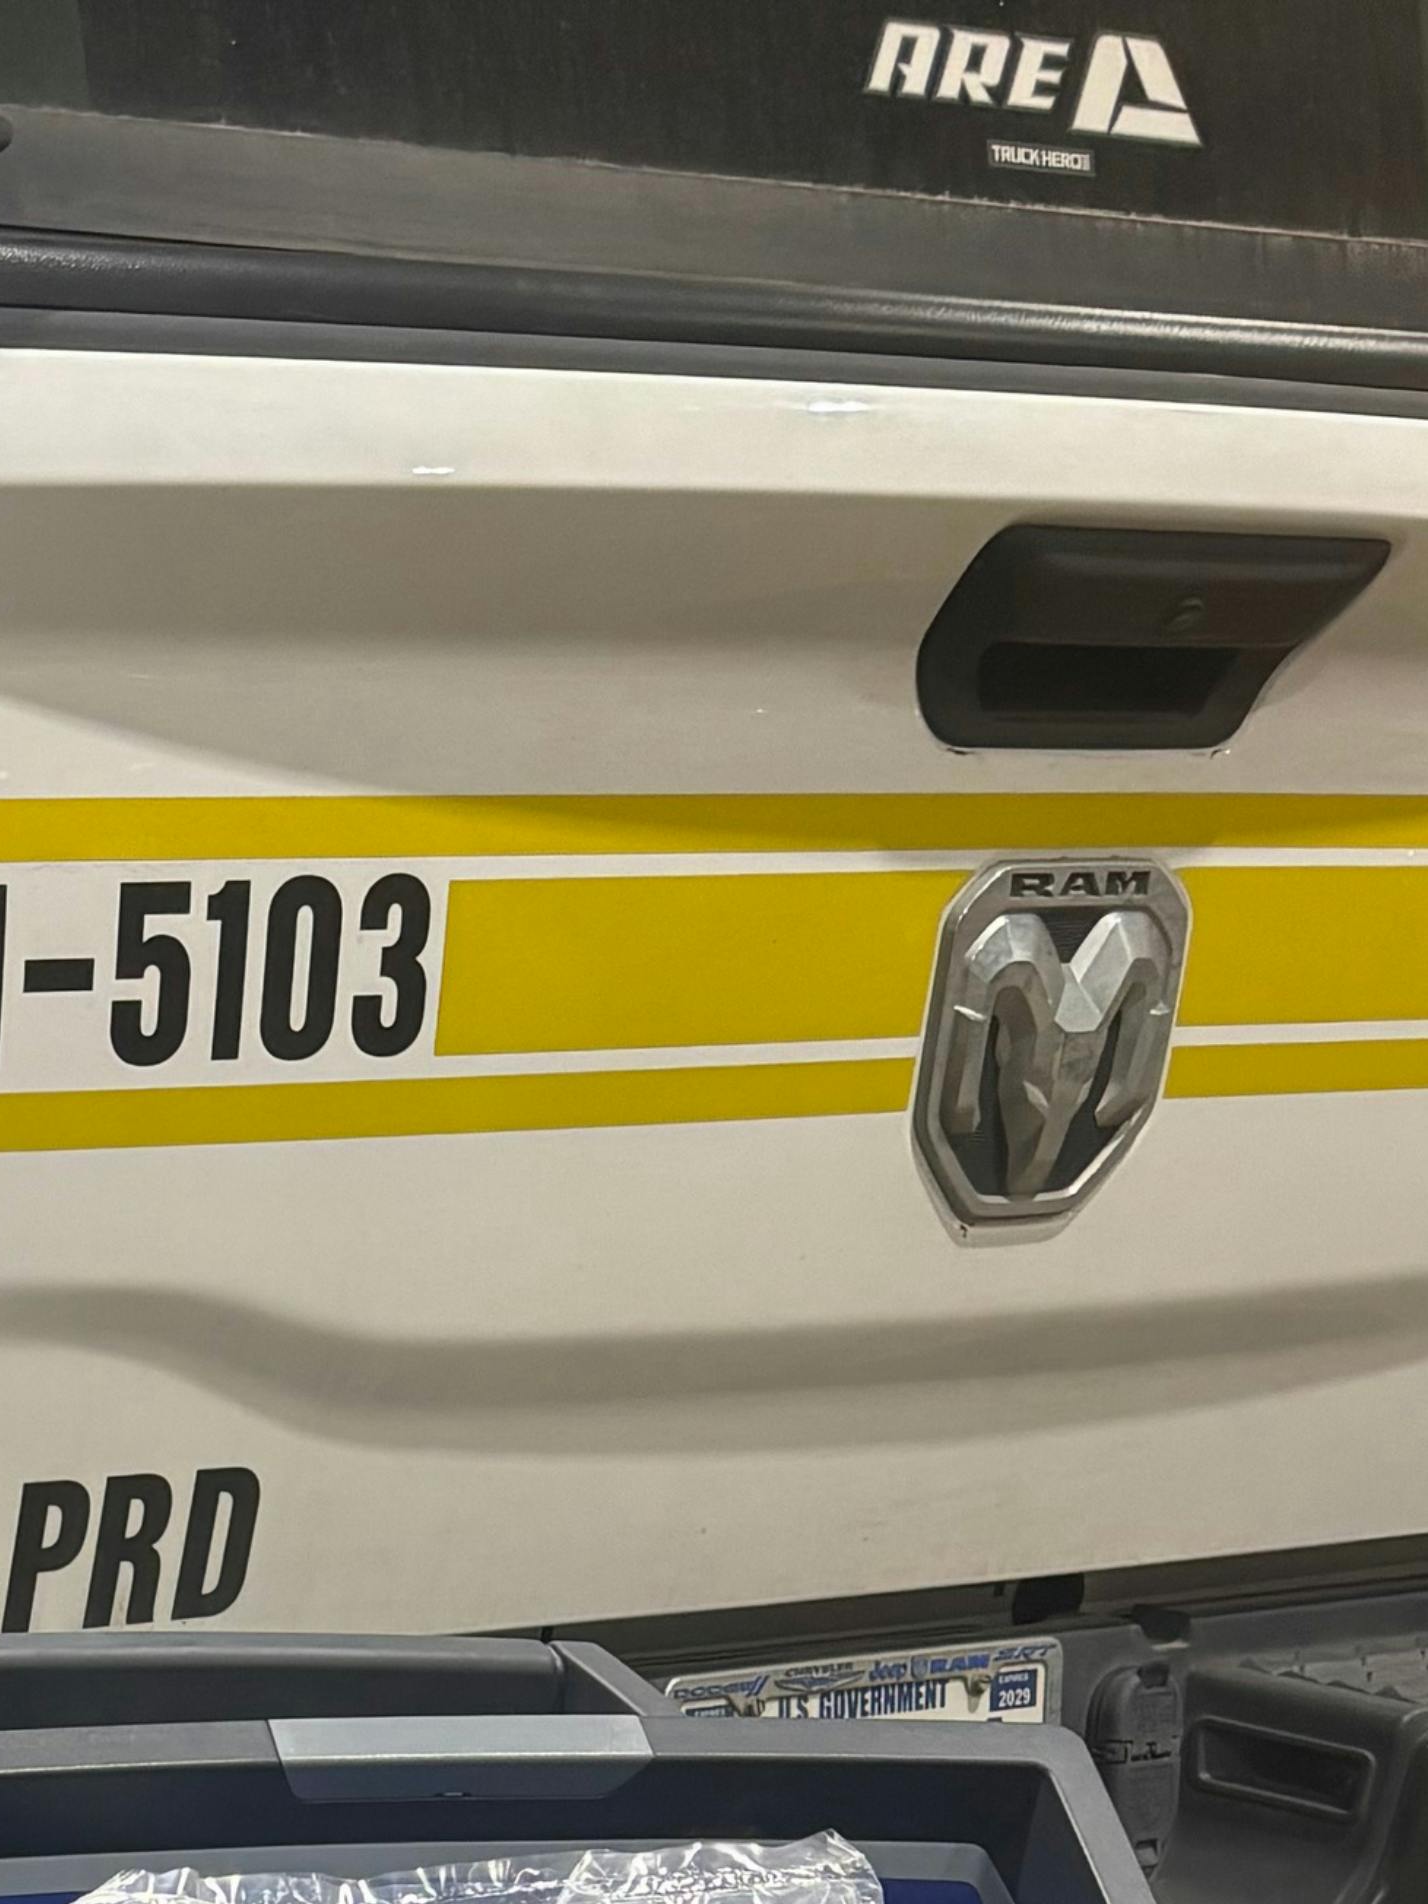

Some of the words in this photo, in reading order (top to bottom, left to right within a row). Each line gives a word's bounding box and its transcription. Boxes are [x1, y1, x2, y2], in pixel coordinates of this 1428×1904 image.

[992, 144, 1039, 166] TRUCK
[1041, 150, 1081, 170] HERO
[1009, 870, 1151, 898] RAM
[930, 1653, 990, 1674] RAM
[819, 1678, 950, 1719] GOVERNMENT
[998, 1688, 1032, 1707] 2029
